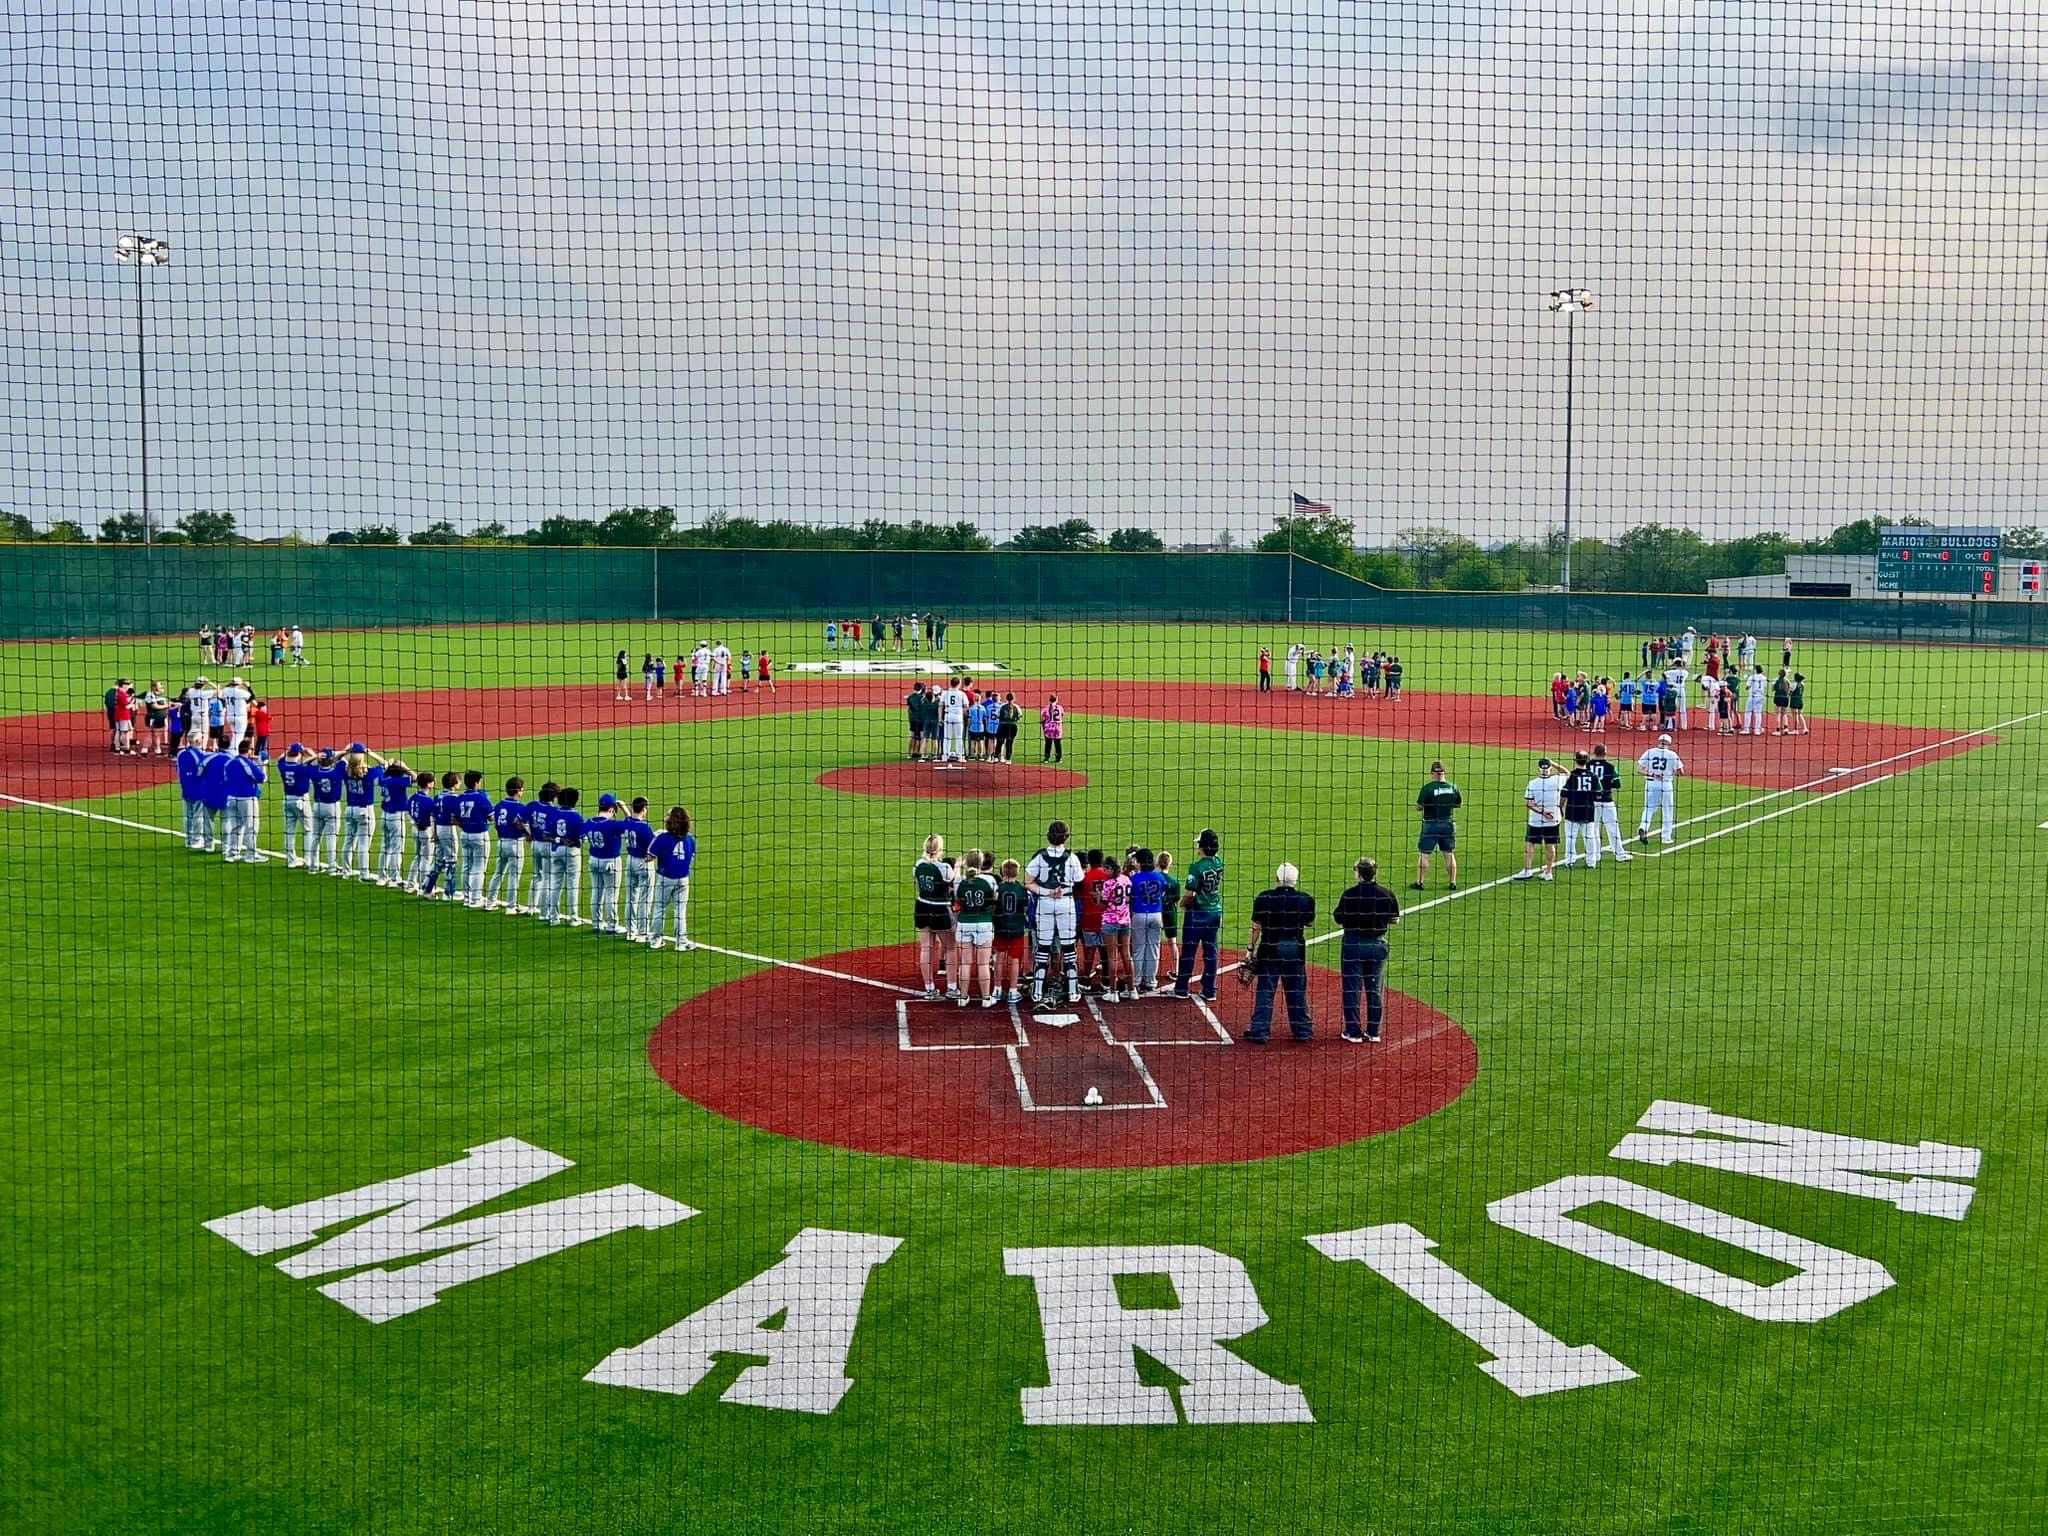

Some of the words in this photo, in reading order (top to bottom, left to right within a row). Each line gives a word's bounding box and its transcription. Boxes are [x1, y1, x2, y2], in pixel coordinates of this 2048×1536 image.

[1882, 536, 1924, 547] MARION
[1941, 537, 1998, 548] BULLDOGS
[950, 696, 956, 706] 6
[1652, 756, 1667, 770] 23
[285, 772, 295, 786] 5
[1577, 776, 1592, 792] 15
[460, 801, 475, 818] 17
[673, 841, 686, 860] 4
[1002, 891, 1017, 915] 0
[204, 1099, 1982, 1426] MARION
